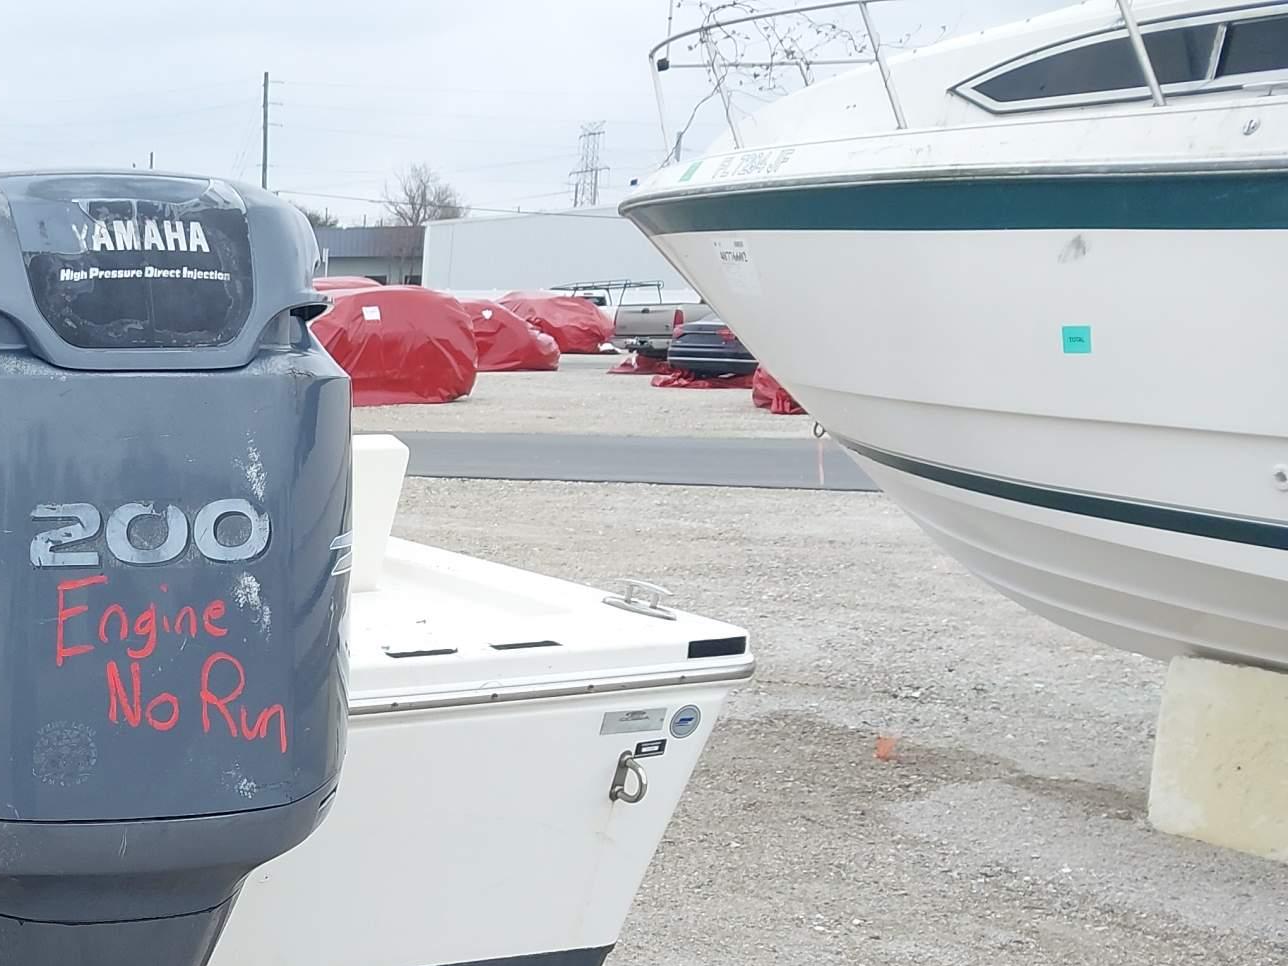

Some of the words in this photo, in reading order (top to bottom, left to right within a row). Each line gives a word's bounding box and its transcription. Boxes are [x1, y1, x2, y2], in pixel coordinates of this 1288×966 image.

[72, 220, 210, 252] YAMAHA
[60, 268, 88, 282] High
[89, 267, 143, 280] Pressure
[144, 266, 181, 279] Direct
[182, 266, 231, 281] Injection
[30, 498, 272, 568] 200
[56, 574, 229, 668] Engine
[106, 660, 180, 731] No
[200, 652, 287, 753] Run
